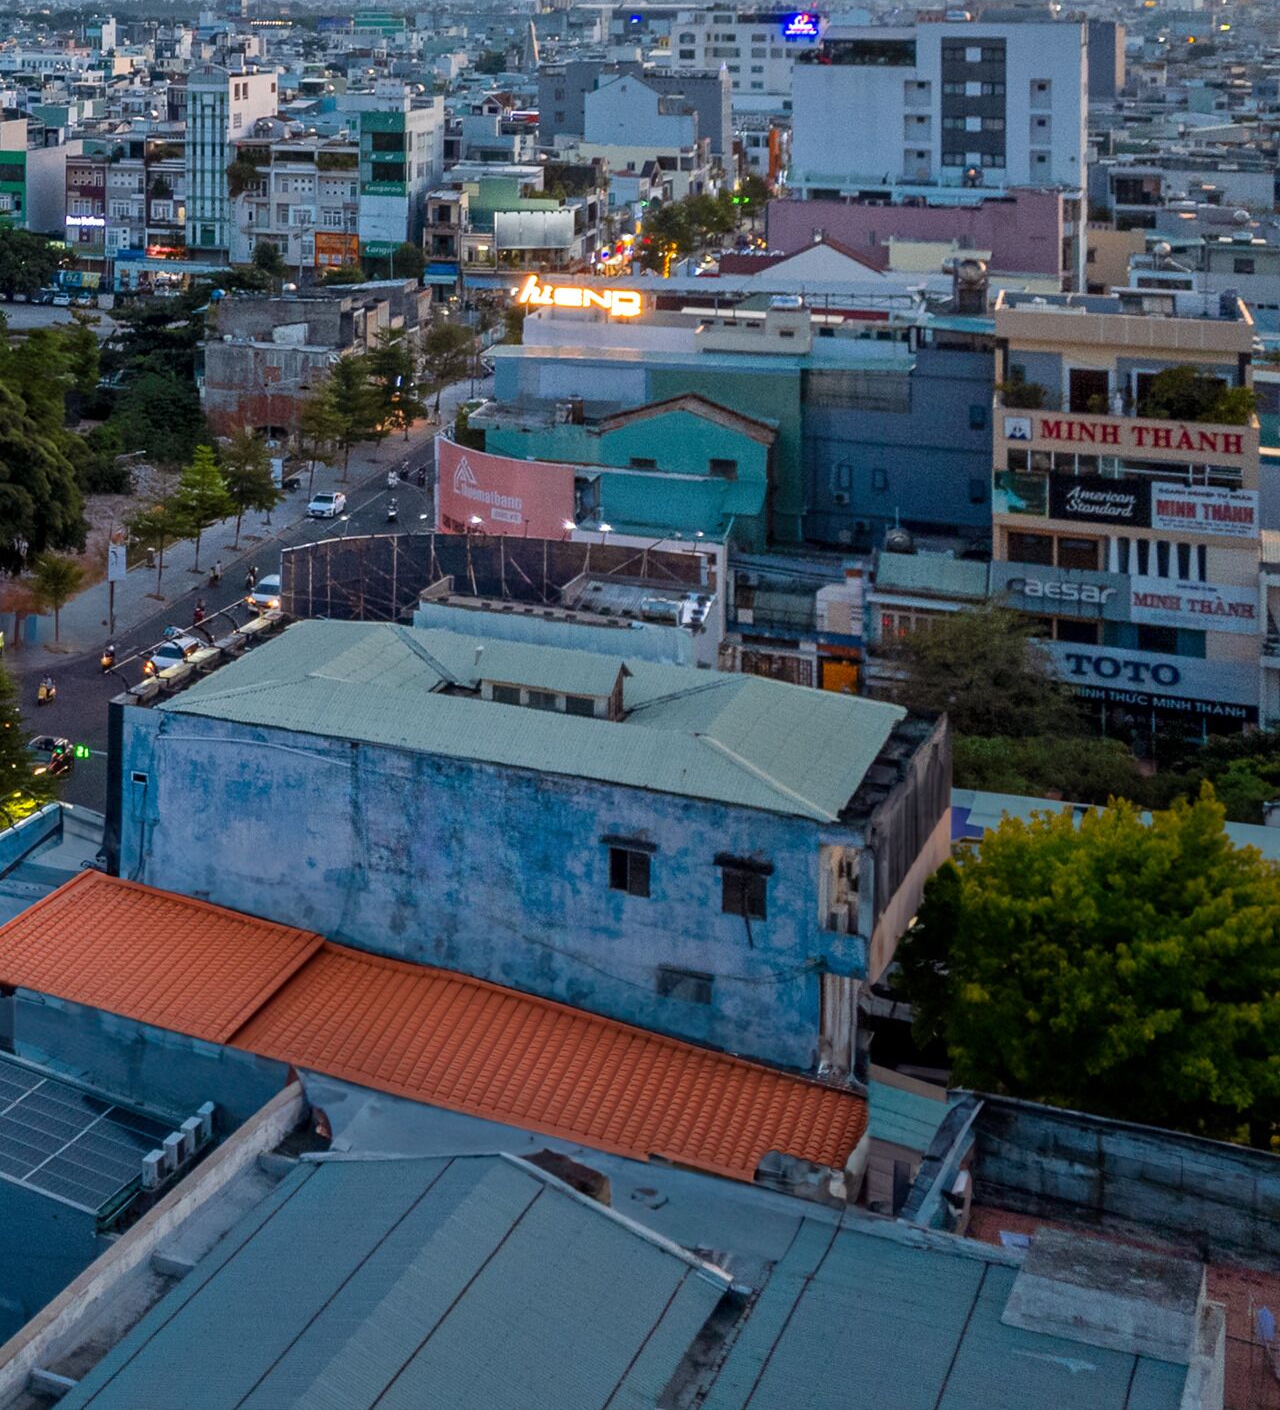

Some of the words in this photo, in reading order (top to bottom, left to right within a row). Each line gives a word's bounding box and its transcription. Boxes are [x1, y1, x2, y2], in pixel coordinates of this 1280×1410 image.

[1040, 419, 1122, 444] MINH
[1131, 424, 1245, 455] THÀNH
[1066, 486, 1136, 505] American
[1065, 498, 1134, 519] Standard
[1156, 499, 1197, 520] MINH
[1132, 592, 1182, 611] MINH
[1187, 596, 1256, 620] THÀNH
[1065, 653, 1181, 687] TOTO
[1152, 697, 1191, 711] MINH
[1196, 700, 1247, 719] THÀNH
